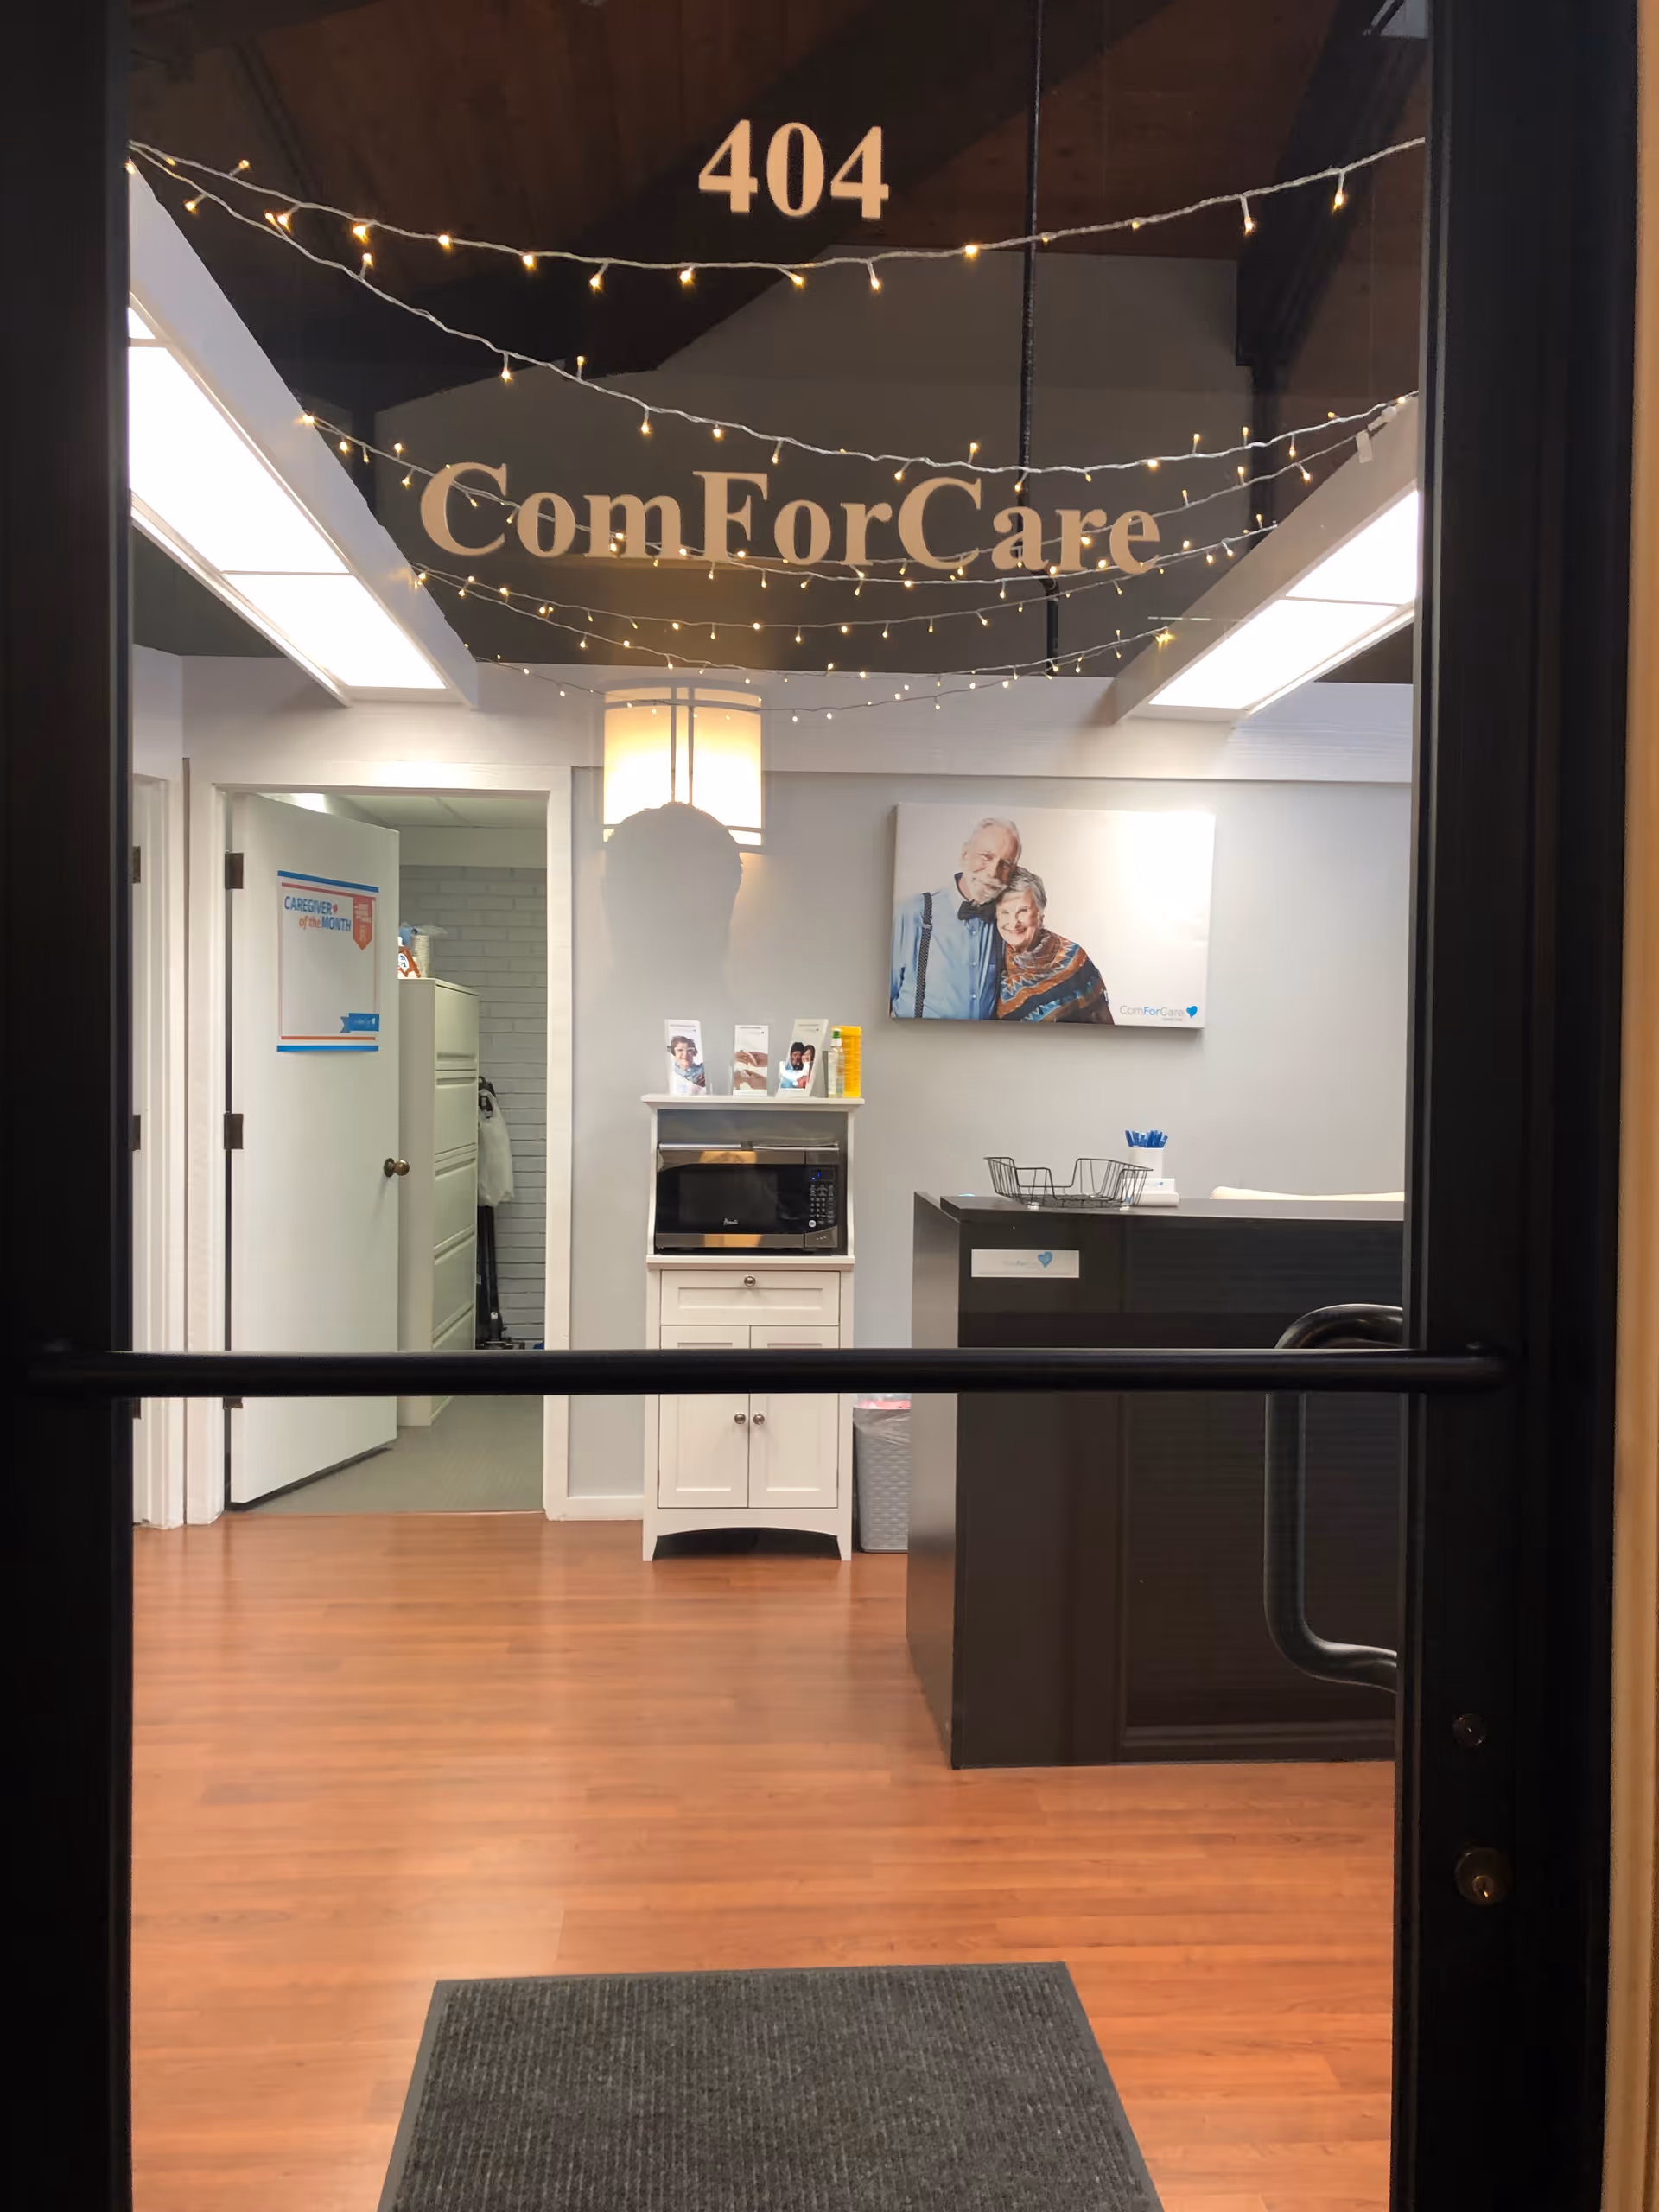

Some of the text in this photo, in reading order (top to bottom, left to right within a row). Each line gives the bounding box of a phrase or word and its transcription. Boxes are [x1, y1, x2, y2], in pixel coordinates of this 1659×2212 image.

[698, 118, 890, 219] 404
[419, 461, 1162, 575] ComForCare
[284, 895, 333, 916] CAREGIVER
[298, 916, 308, 930] of
[321, 916, 352, 931] MONTH
[1119, 1005, 1185, 1017] ComForCare
